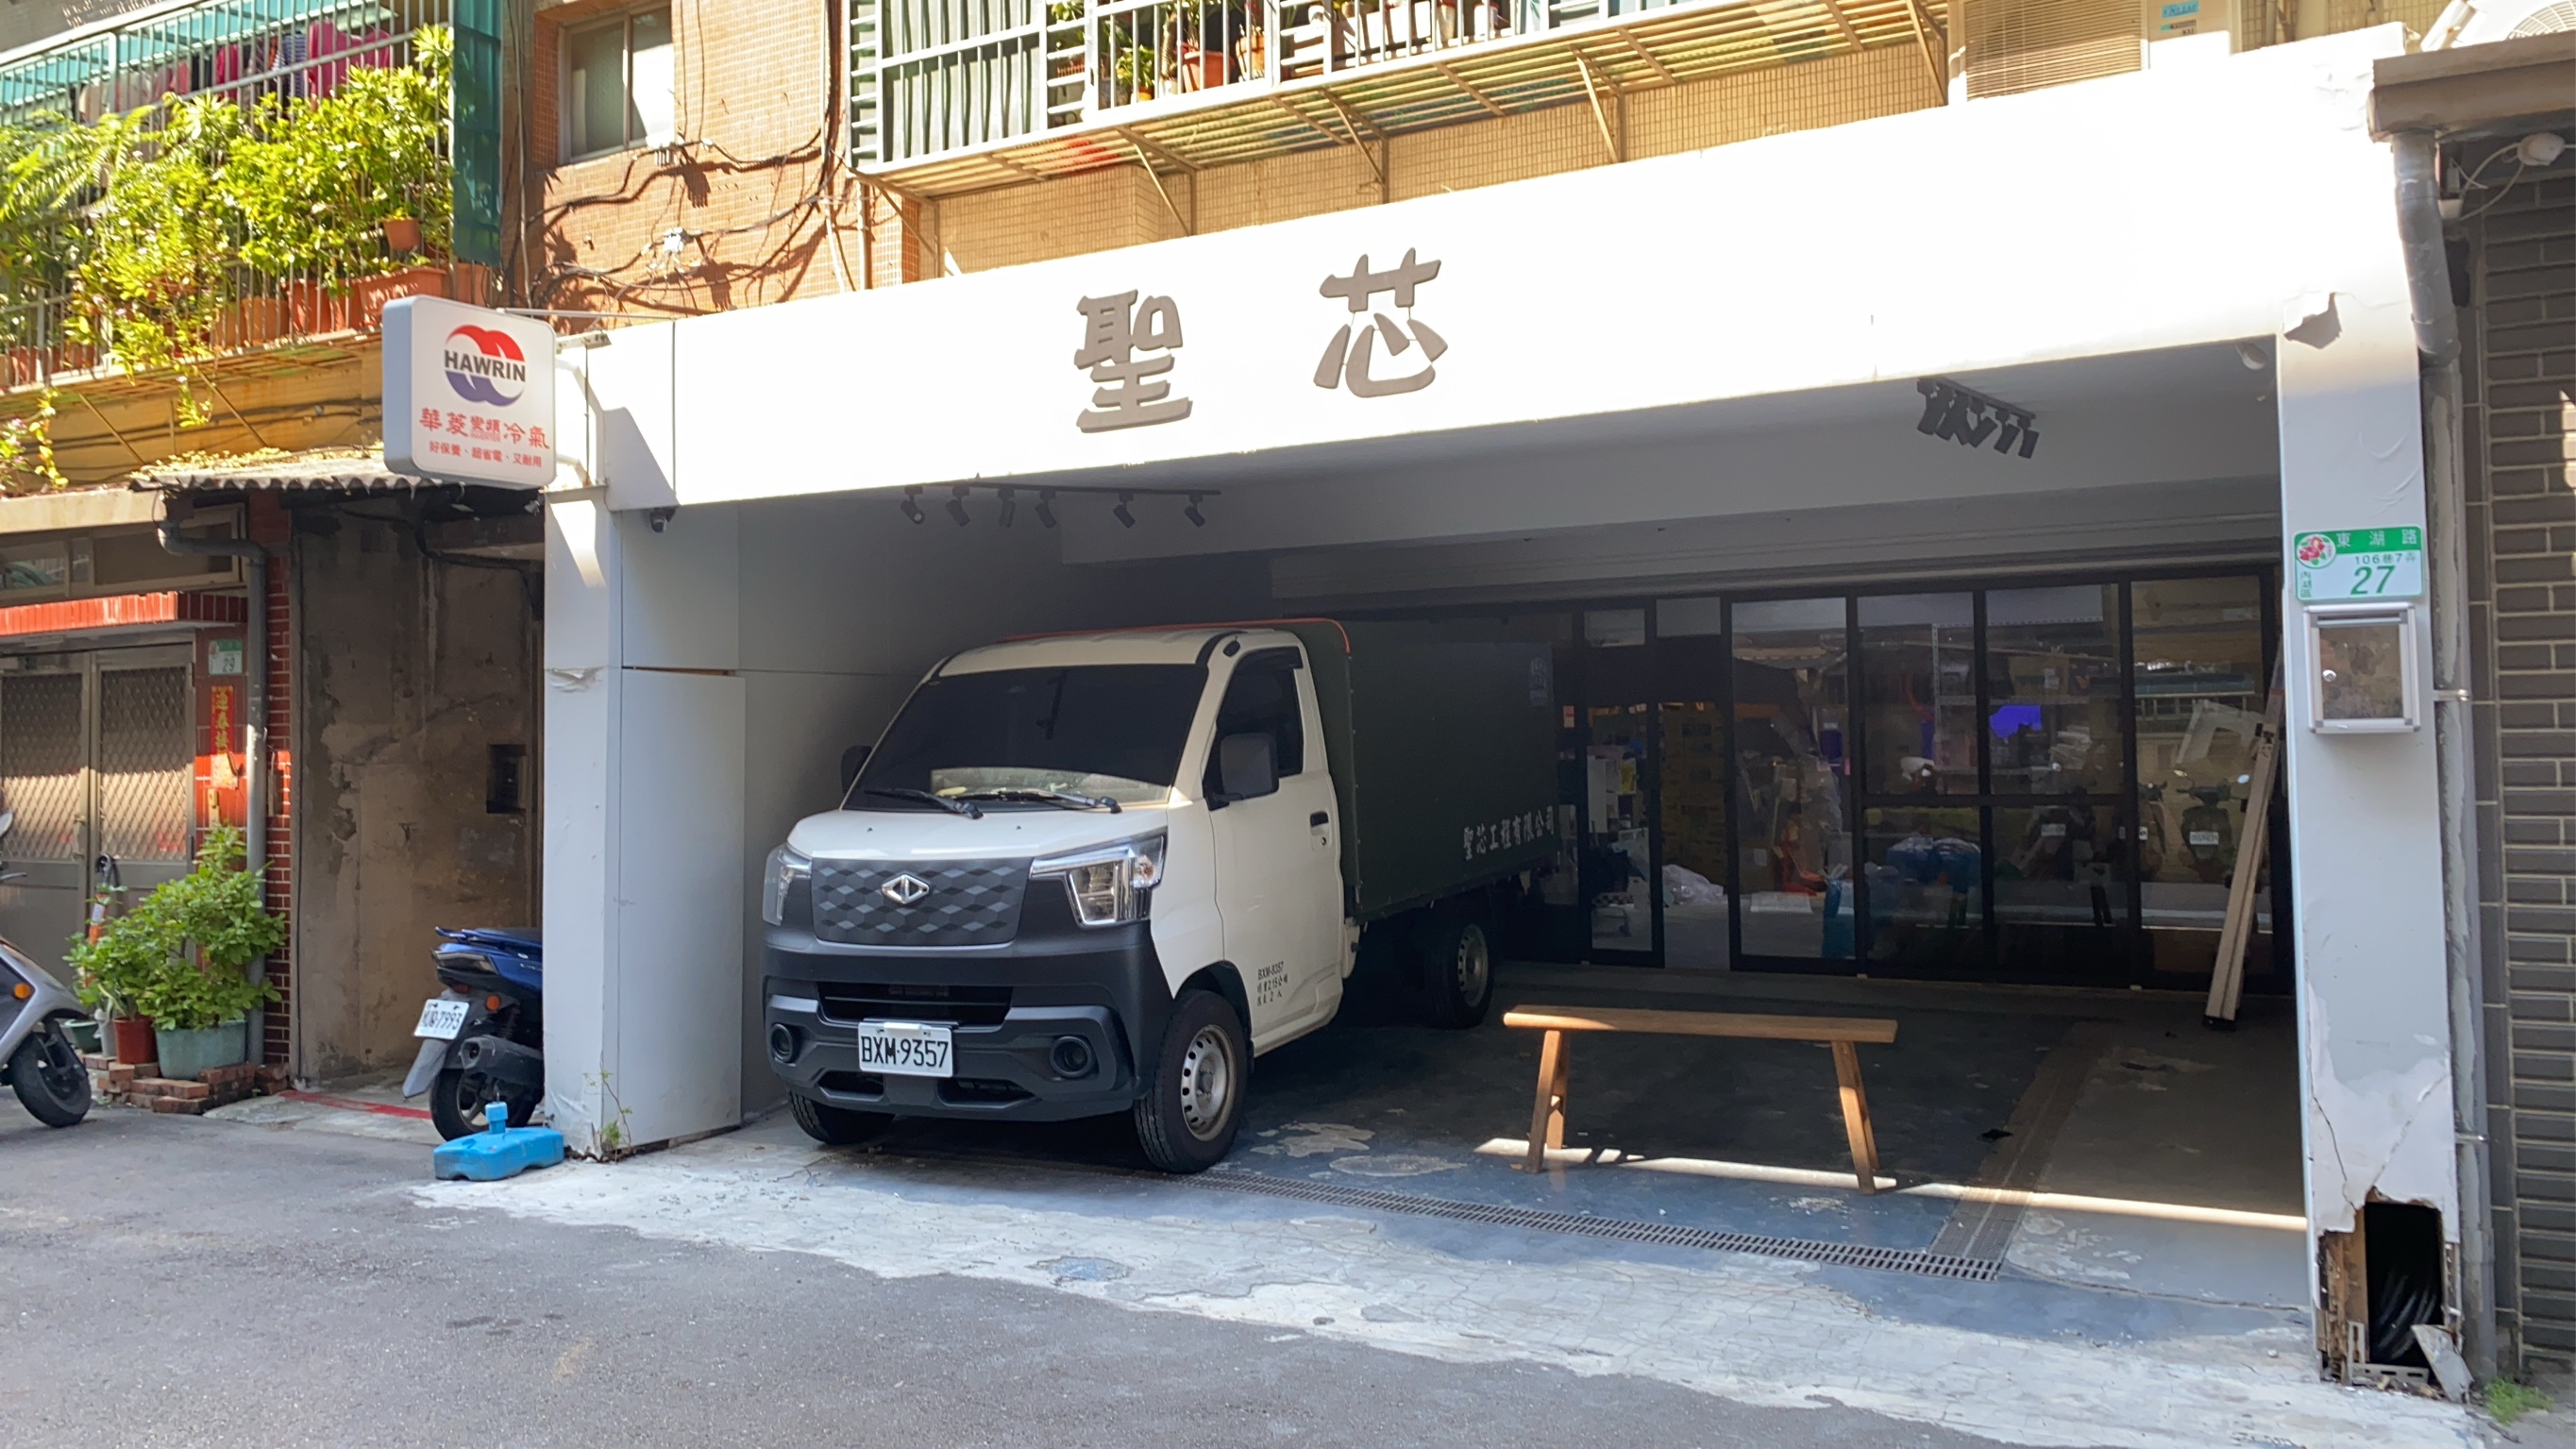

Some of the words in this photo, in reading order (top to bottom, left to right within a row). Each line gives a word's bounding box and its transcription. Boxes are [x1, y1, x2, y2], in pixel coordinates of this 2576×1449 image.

[1073, 246, 1449, 434] 聖芯
[444, 349, 526, 382] HAWRIN
[2336, 529, 2417, 548] 東湖路
[2349, 564, 2396, 596] 27
[861, 1036, 949, 1068] BXM-9357
